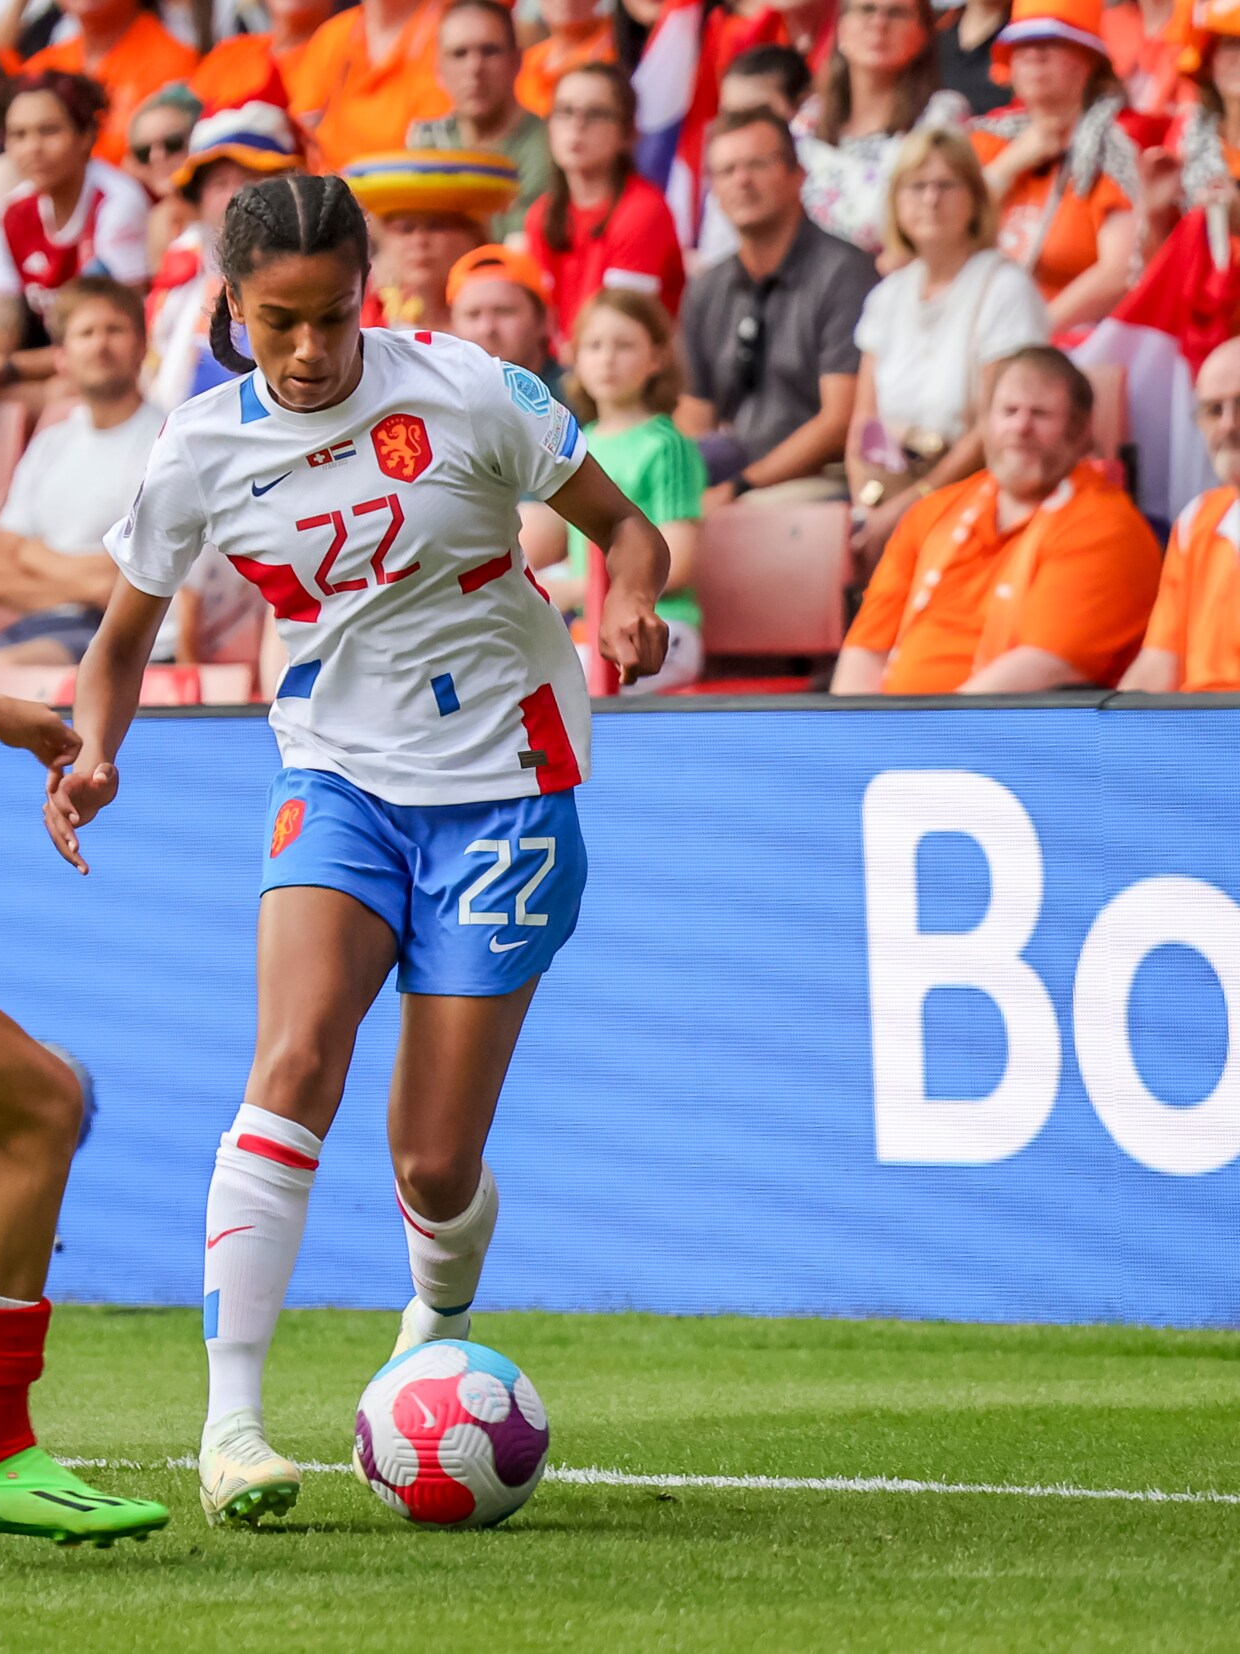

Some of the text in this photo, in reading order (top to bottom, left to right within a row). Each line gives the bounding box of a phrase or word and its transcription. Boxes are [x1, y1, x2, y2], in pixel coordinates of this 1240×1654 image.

[295, 493, 421, 597] 22
[458, 836, 556, 926] 22
[862, 769, 1240, 1177] Bo
